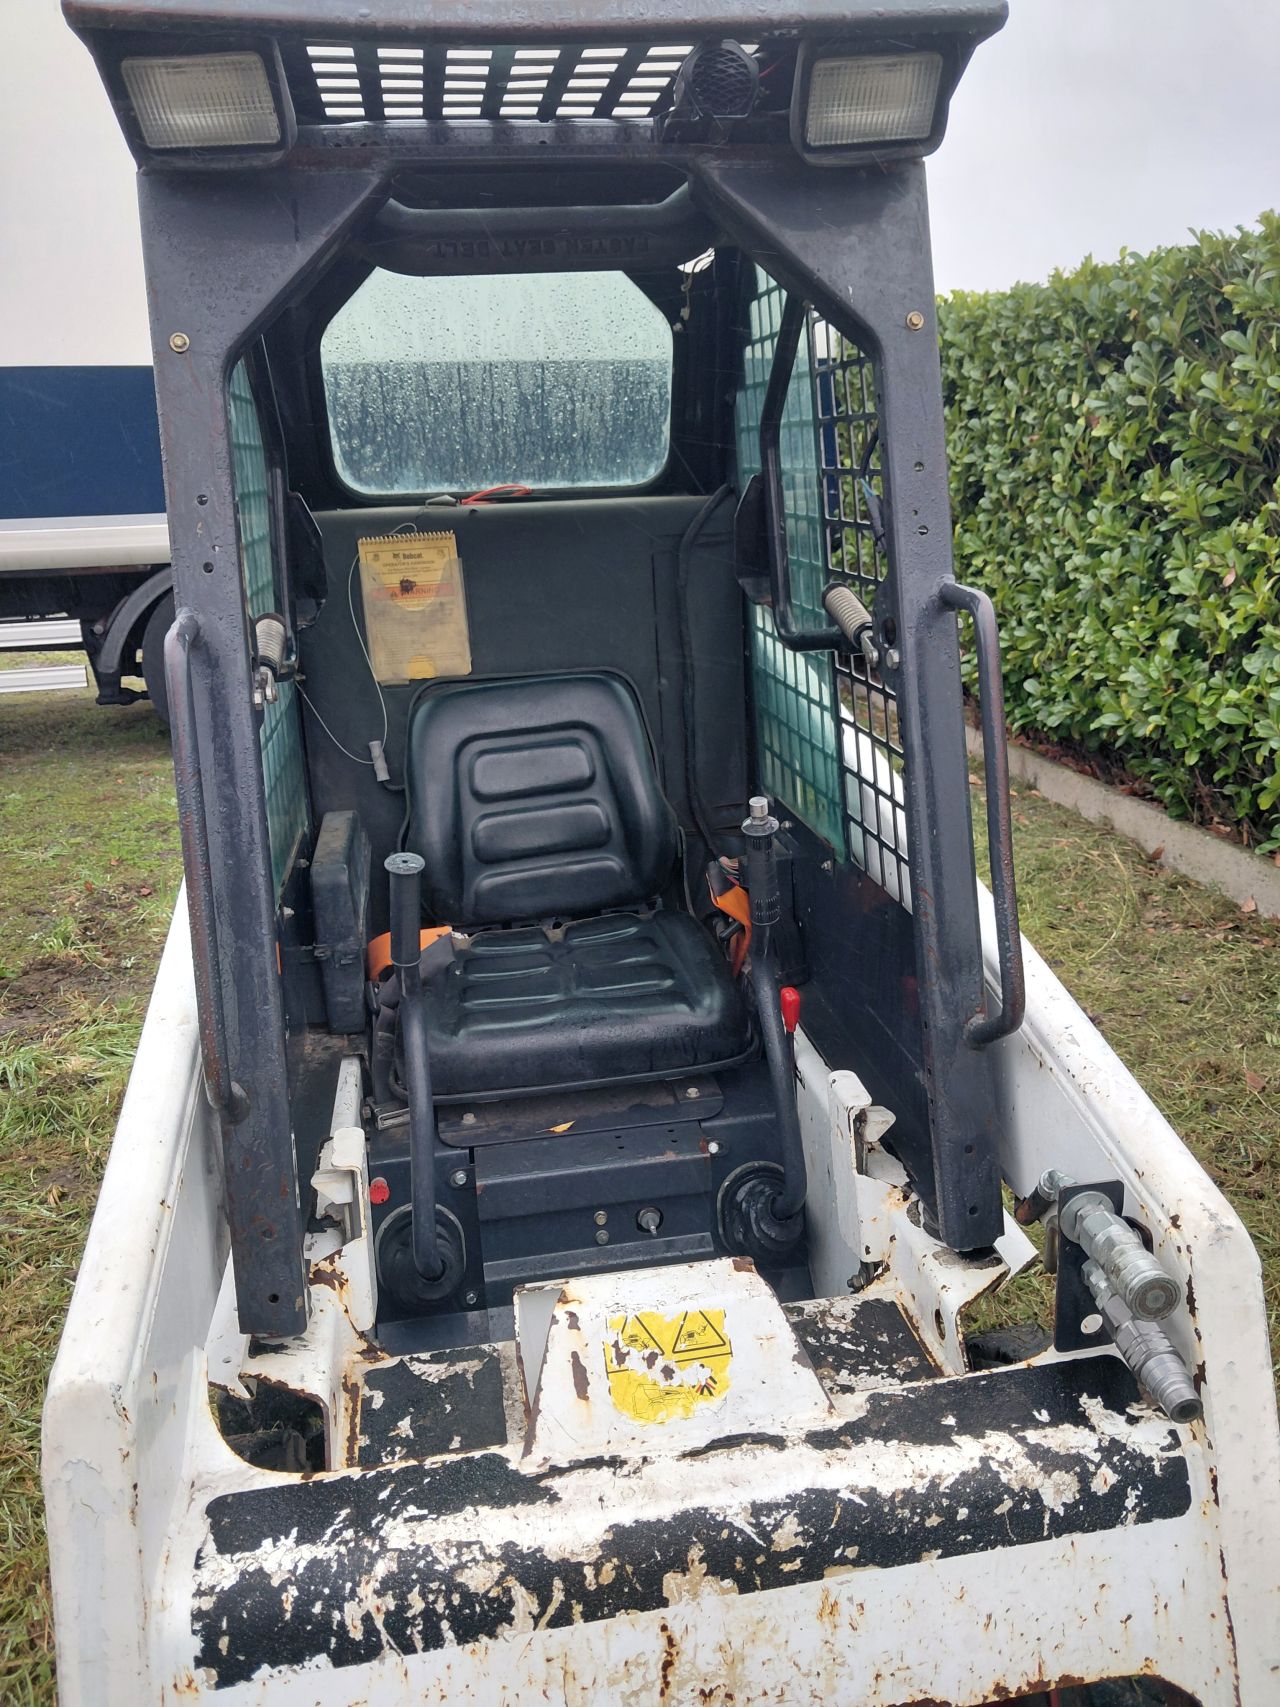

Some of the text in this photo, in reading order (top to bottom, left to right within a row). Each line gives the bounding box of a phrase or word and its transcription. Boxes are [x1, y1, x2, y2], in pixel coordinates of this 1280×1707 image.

[432, 236, 649, 257] FASTEN SEAT BELT
